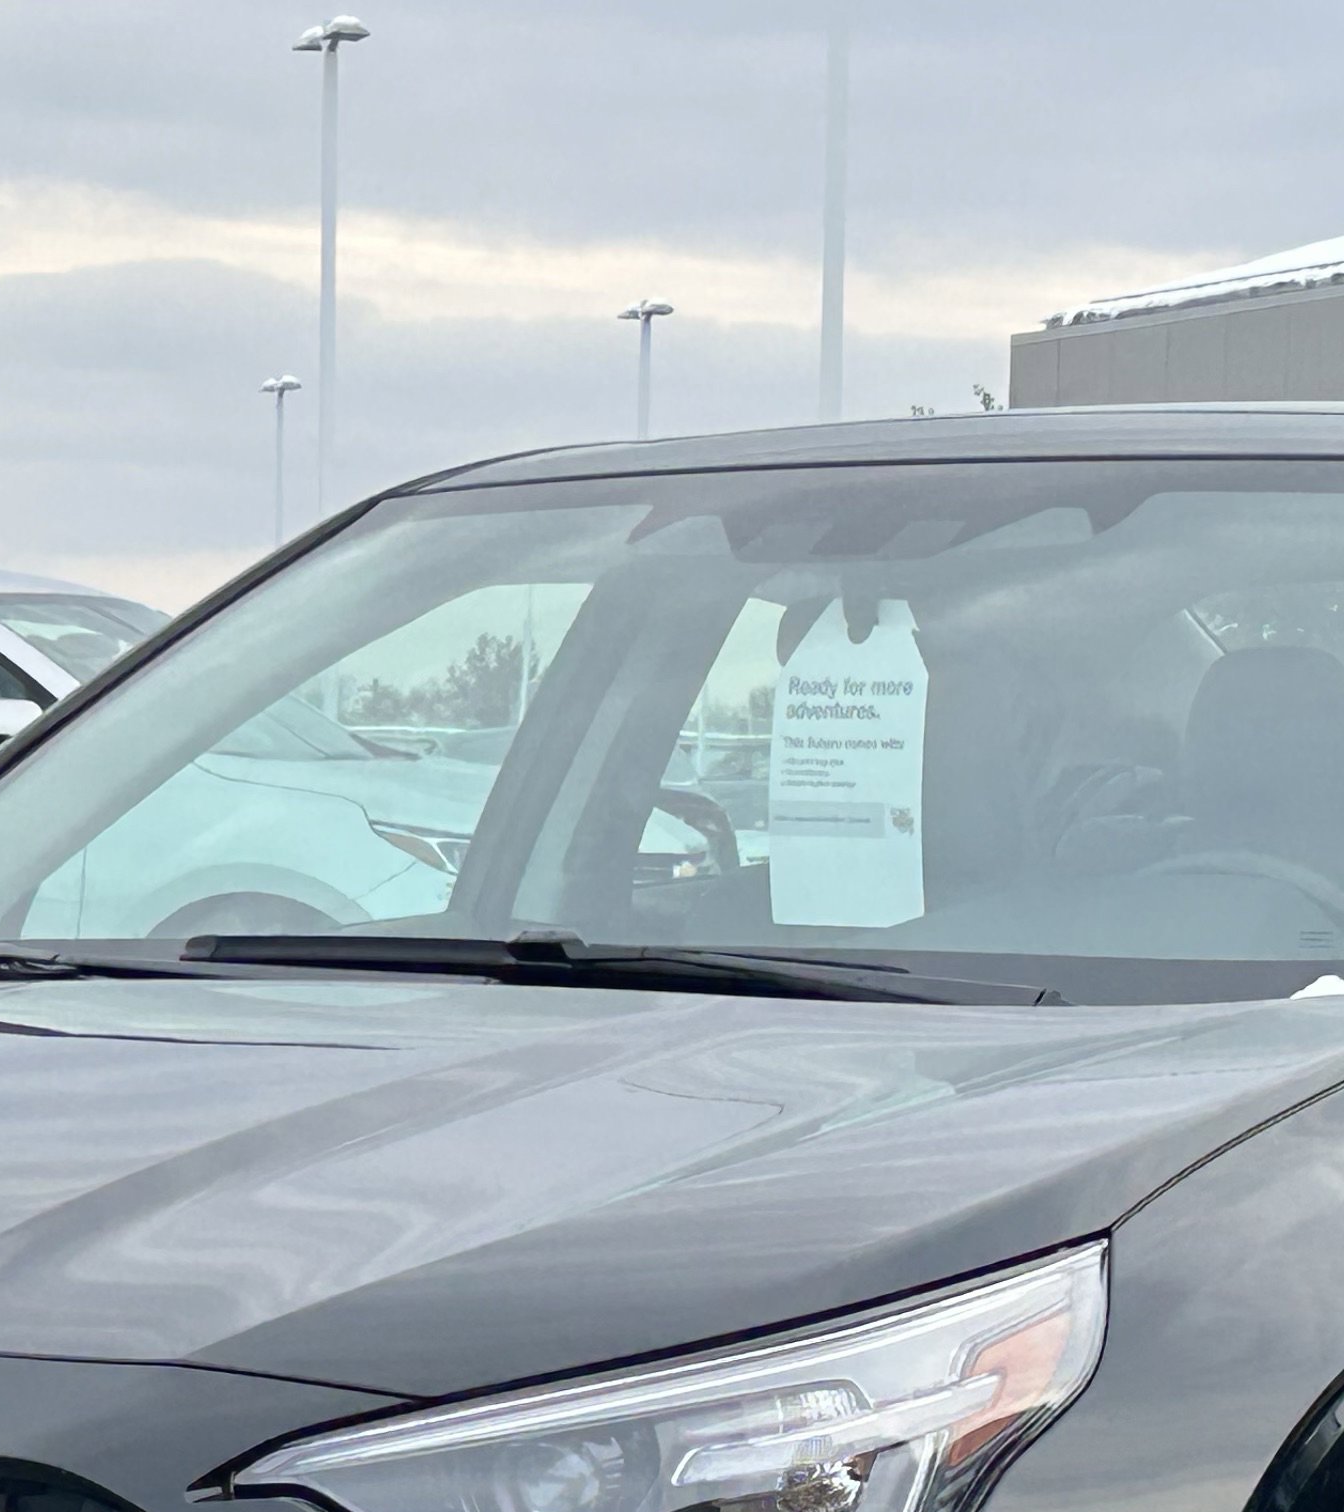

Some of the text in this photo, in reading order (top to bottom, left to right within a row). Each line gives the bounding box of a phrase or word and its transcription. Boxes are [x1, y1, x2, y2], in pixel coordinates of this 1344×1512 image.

[789, 676, 914, 699] Ready for more
[786, 702, 881, 719] adventures.
